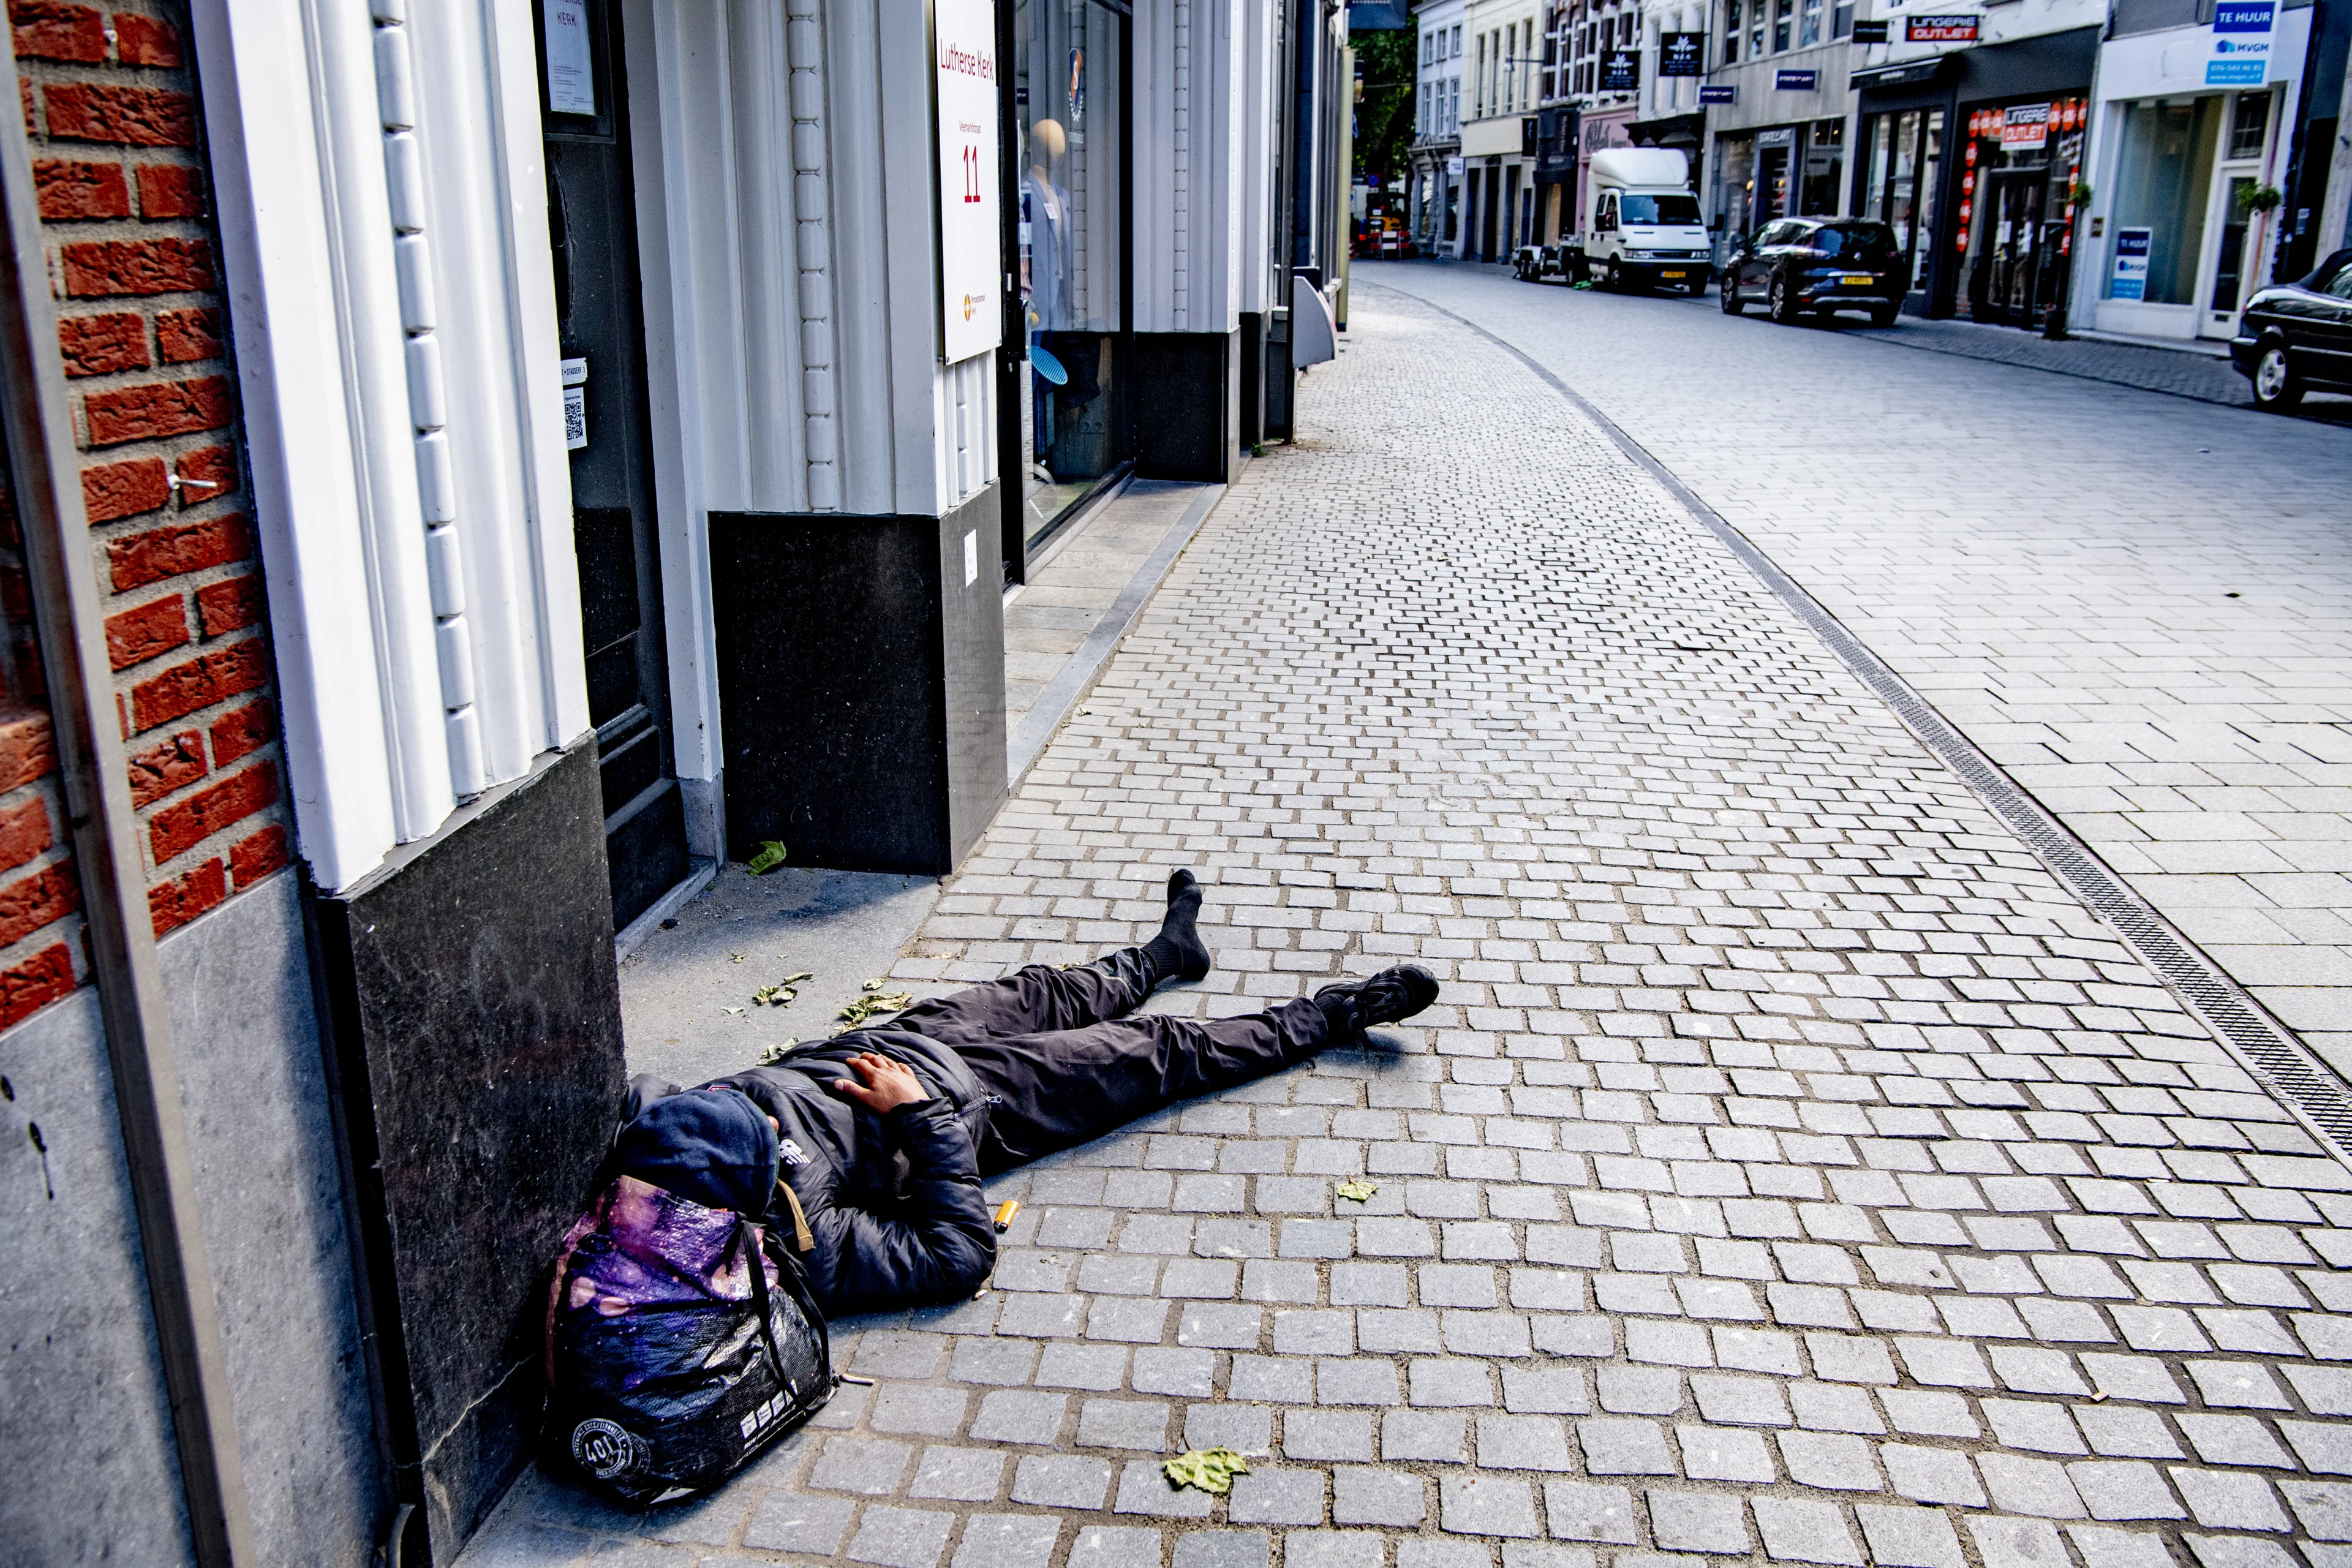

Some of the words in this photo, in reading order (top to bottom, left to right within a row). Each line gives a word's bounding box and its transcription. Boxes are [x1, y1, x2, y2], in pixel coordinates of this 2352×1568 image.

[557, 11, 576, 27] KERK
[1912, 17, 1976, 28] LINGERIE
[2219, 12, 2234, 23] TE
[2234, 11, 2271, 23] HUUR
[1912, 27, 1973, 39] OUTLET
[2237, 43, 2269, 52] MVGM
[940, 38, 976, 77] Lutherse
[977, 49, 993, 81] Kerk
[2005, 124, 2045, 141] OUTLET
[963, 145, 981, 203] 11
[567, 366, 582, 375] STADSERF
